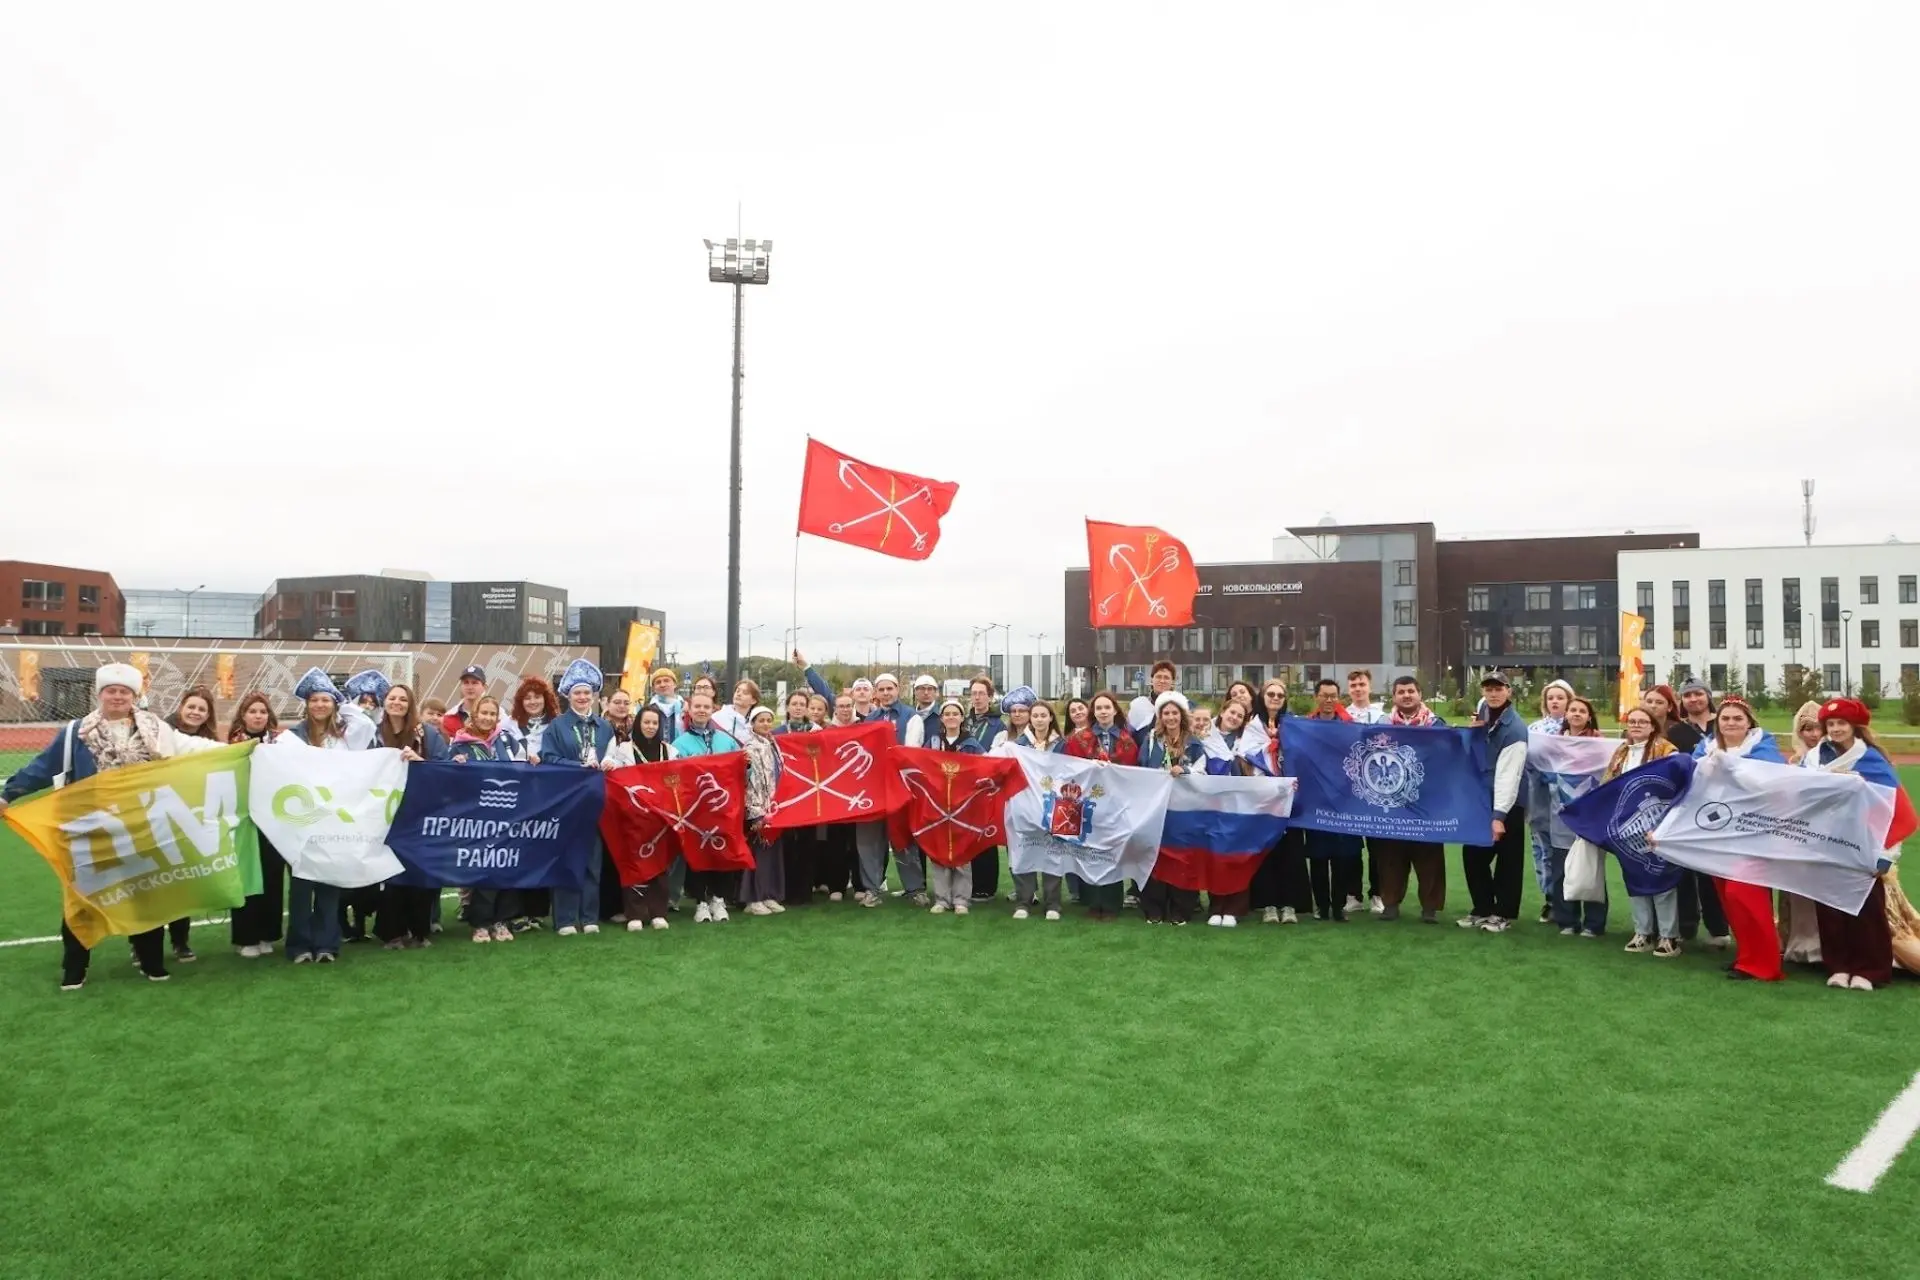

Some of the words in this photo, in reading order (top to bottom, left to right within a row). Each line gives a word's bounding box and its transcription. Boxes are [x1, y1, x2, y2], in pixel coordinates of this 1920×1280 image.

[1197, 583, 1213, 593] НТР
[1222, 580, 1303, 593] НОВОКОЛЬЦОВСКИЙ
[1315, 808, 1373, 823] РОССИЙСКИЙ
[1373, 815, 1460, 826] ГОСУДАРСТВЕННЫЙ
[1316, 818, 1395, 831] ПЕДАГОГИЧЕСКИЙ
[1396, 824, 1458, 833] УНИВЕРСИТЕТ
[421, 816, 561, 840] ПРИМОРСКИЙ
[456, 843, 520, 868] РАЙОН
